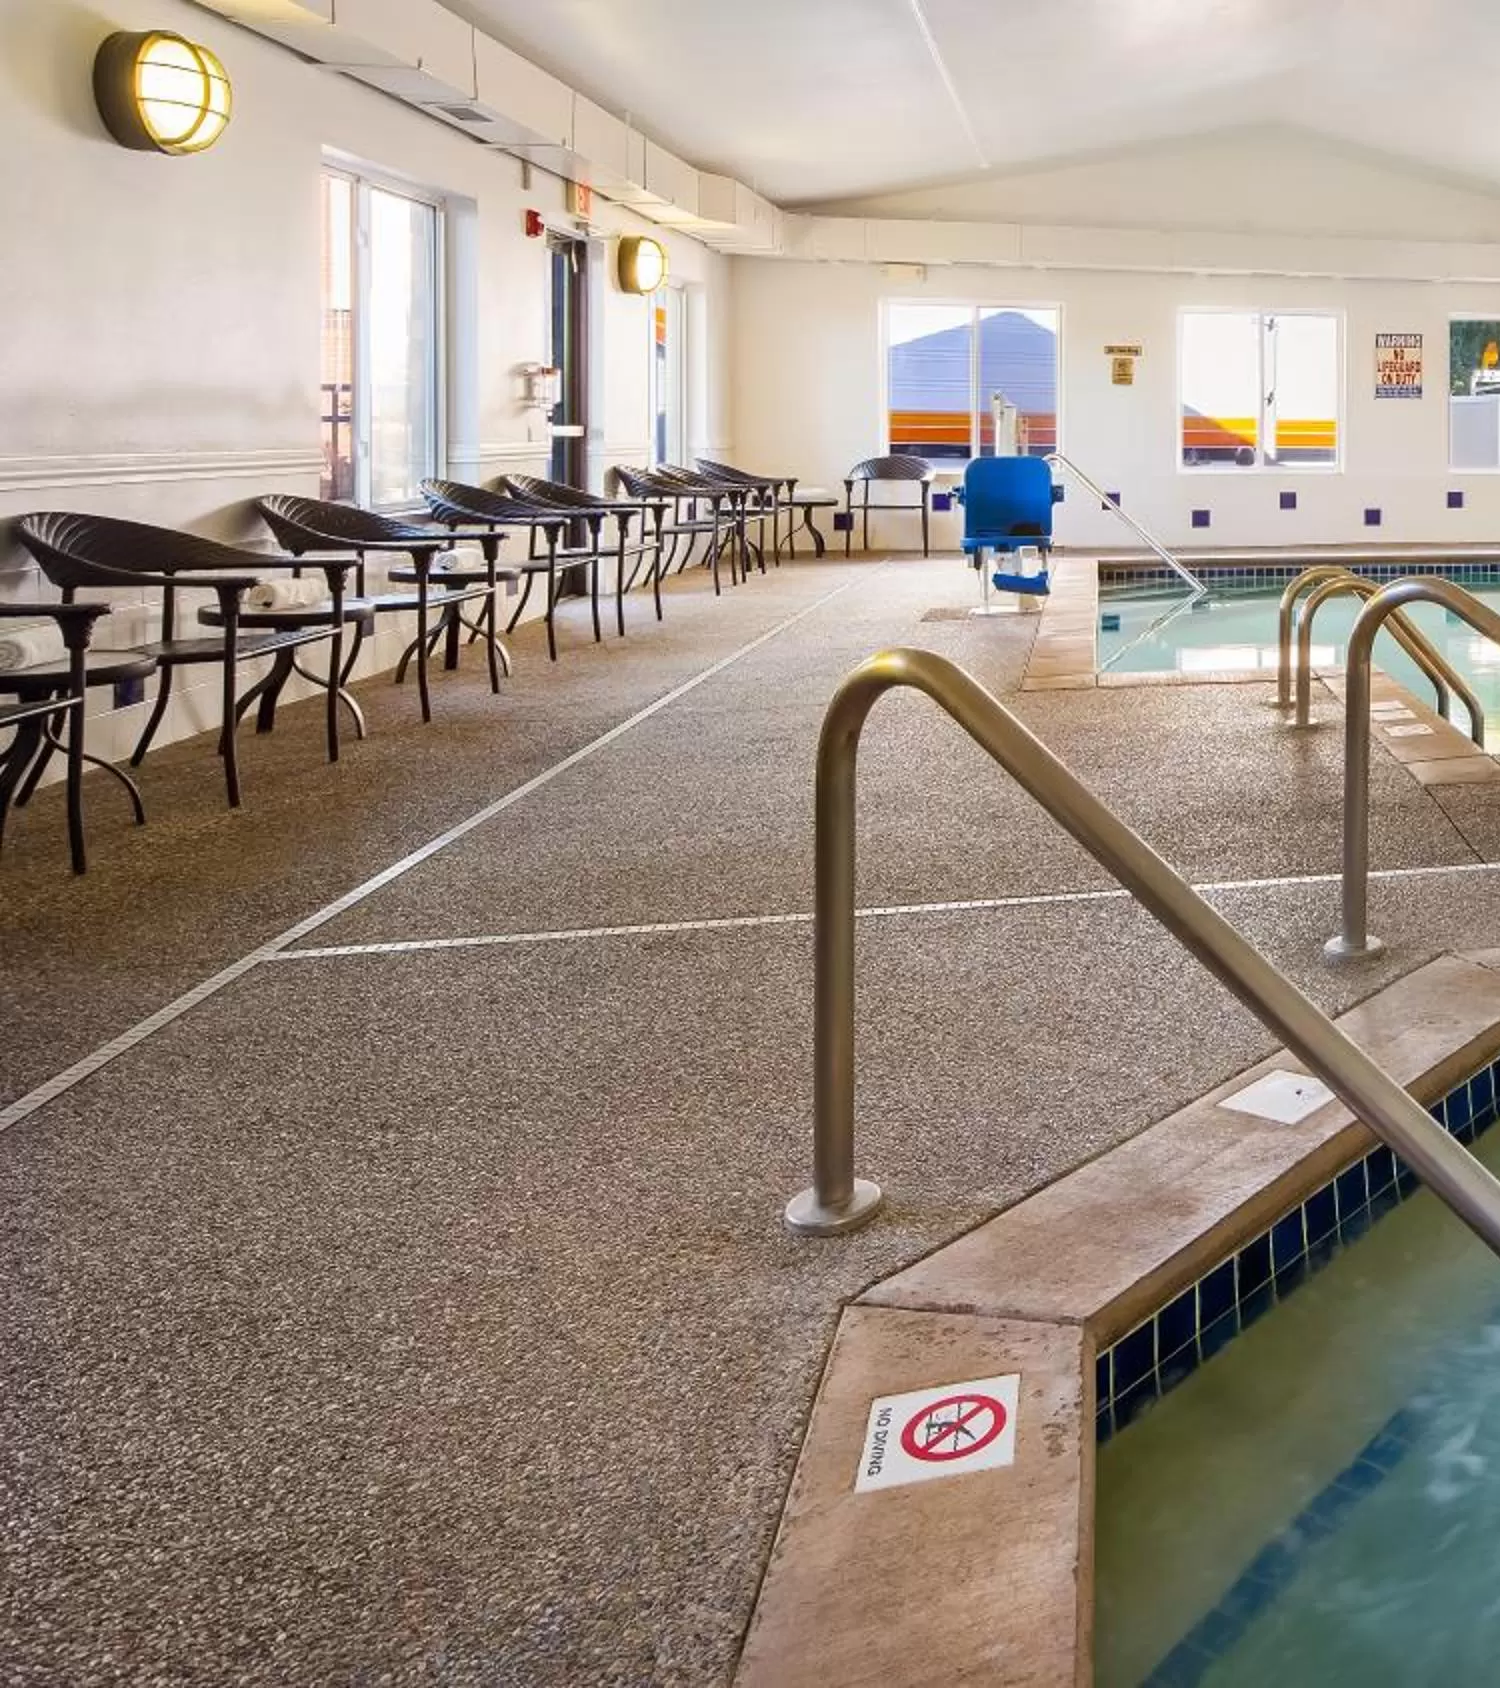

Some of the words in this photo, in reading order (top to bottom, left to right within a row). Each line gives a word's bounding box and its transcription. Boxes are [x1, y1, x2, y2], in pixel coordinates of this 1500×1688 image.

[1378, 335, 1420, 347] WARNING
[1394, 349, 1405, 360] NO
[1377, 361, 1421, 373] LIFEGUARD
[1382, 374, 1393, 385] ON
[1395, 374, 1417, 385] DUTY
[876, 1407, 893, 1427] NO
[867, 1429, 889, 1477] DIVING
